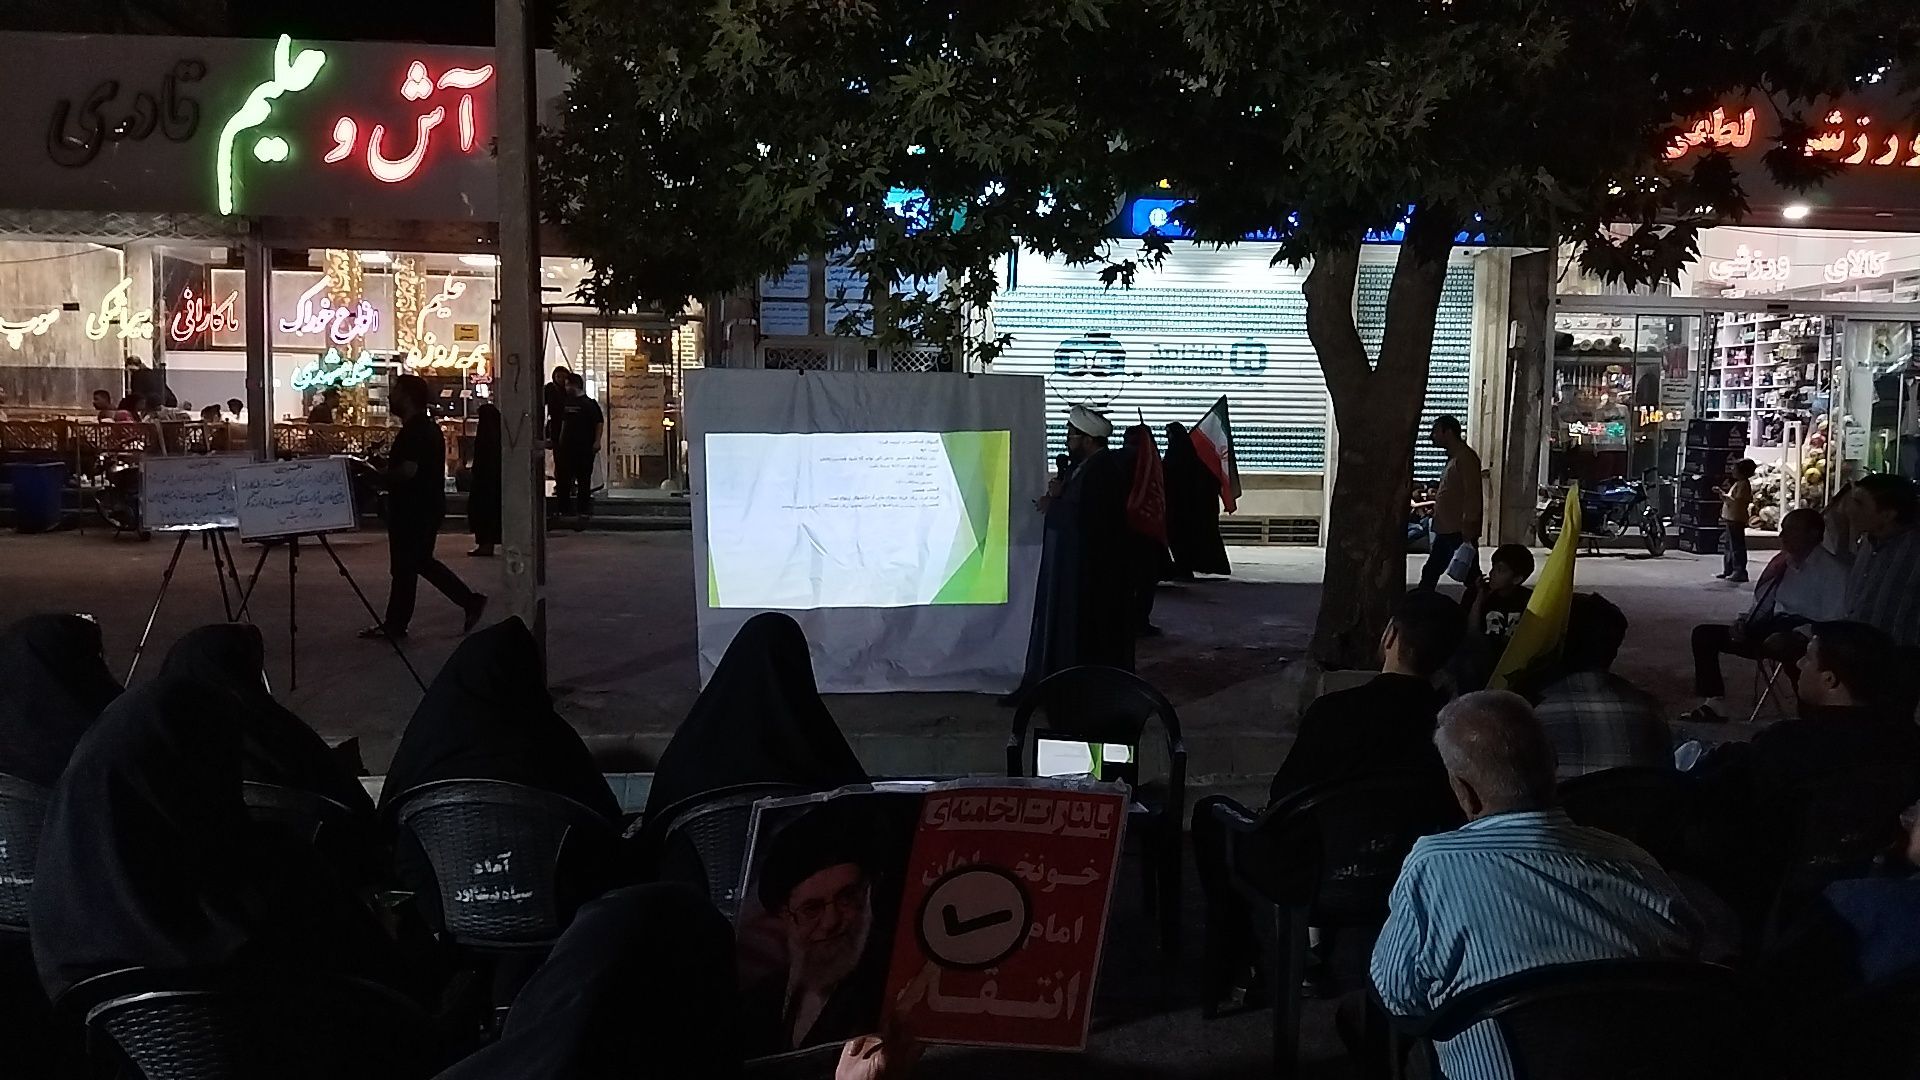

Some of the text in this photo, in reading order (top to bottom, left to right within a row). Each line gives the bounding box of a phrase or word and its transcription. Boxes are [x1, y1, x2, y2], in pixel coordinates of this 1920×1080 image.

[325, 116, 357, 163] و
[368, 61, 494, 182] آش
[1709, 244, 1890, 283] کالای ورزشی
[0, 308, 60, 350] سوپ
[86, 277, 154, 340] پیراشکی
[279, 274, 379, 344] انواع خوراک
[1022, 912, 1086, 950] امام
